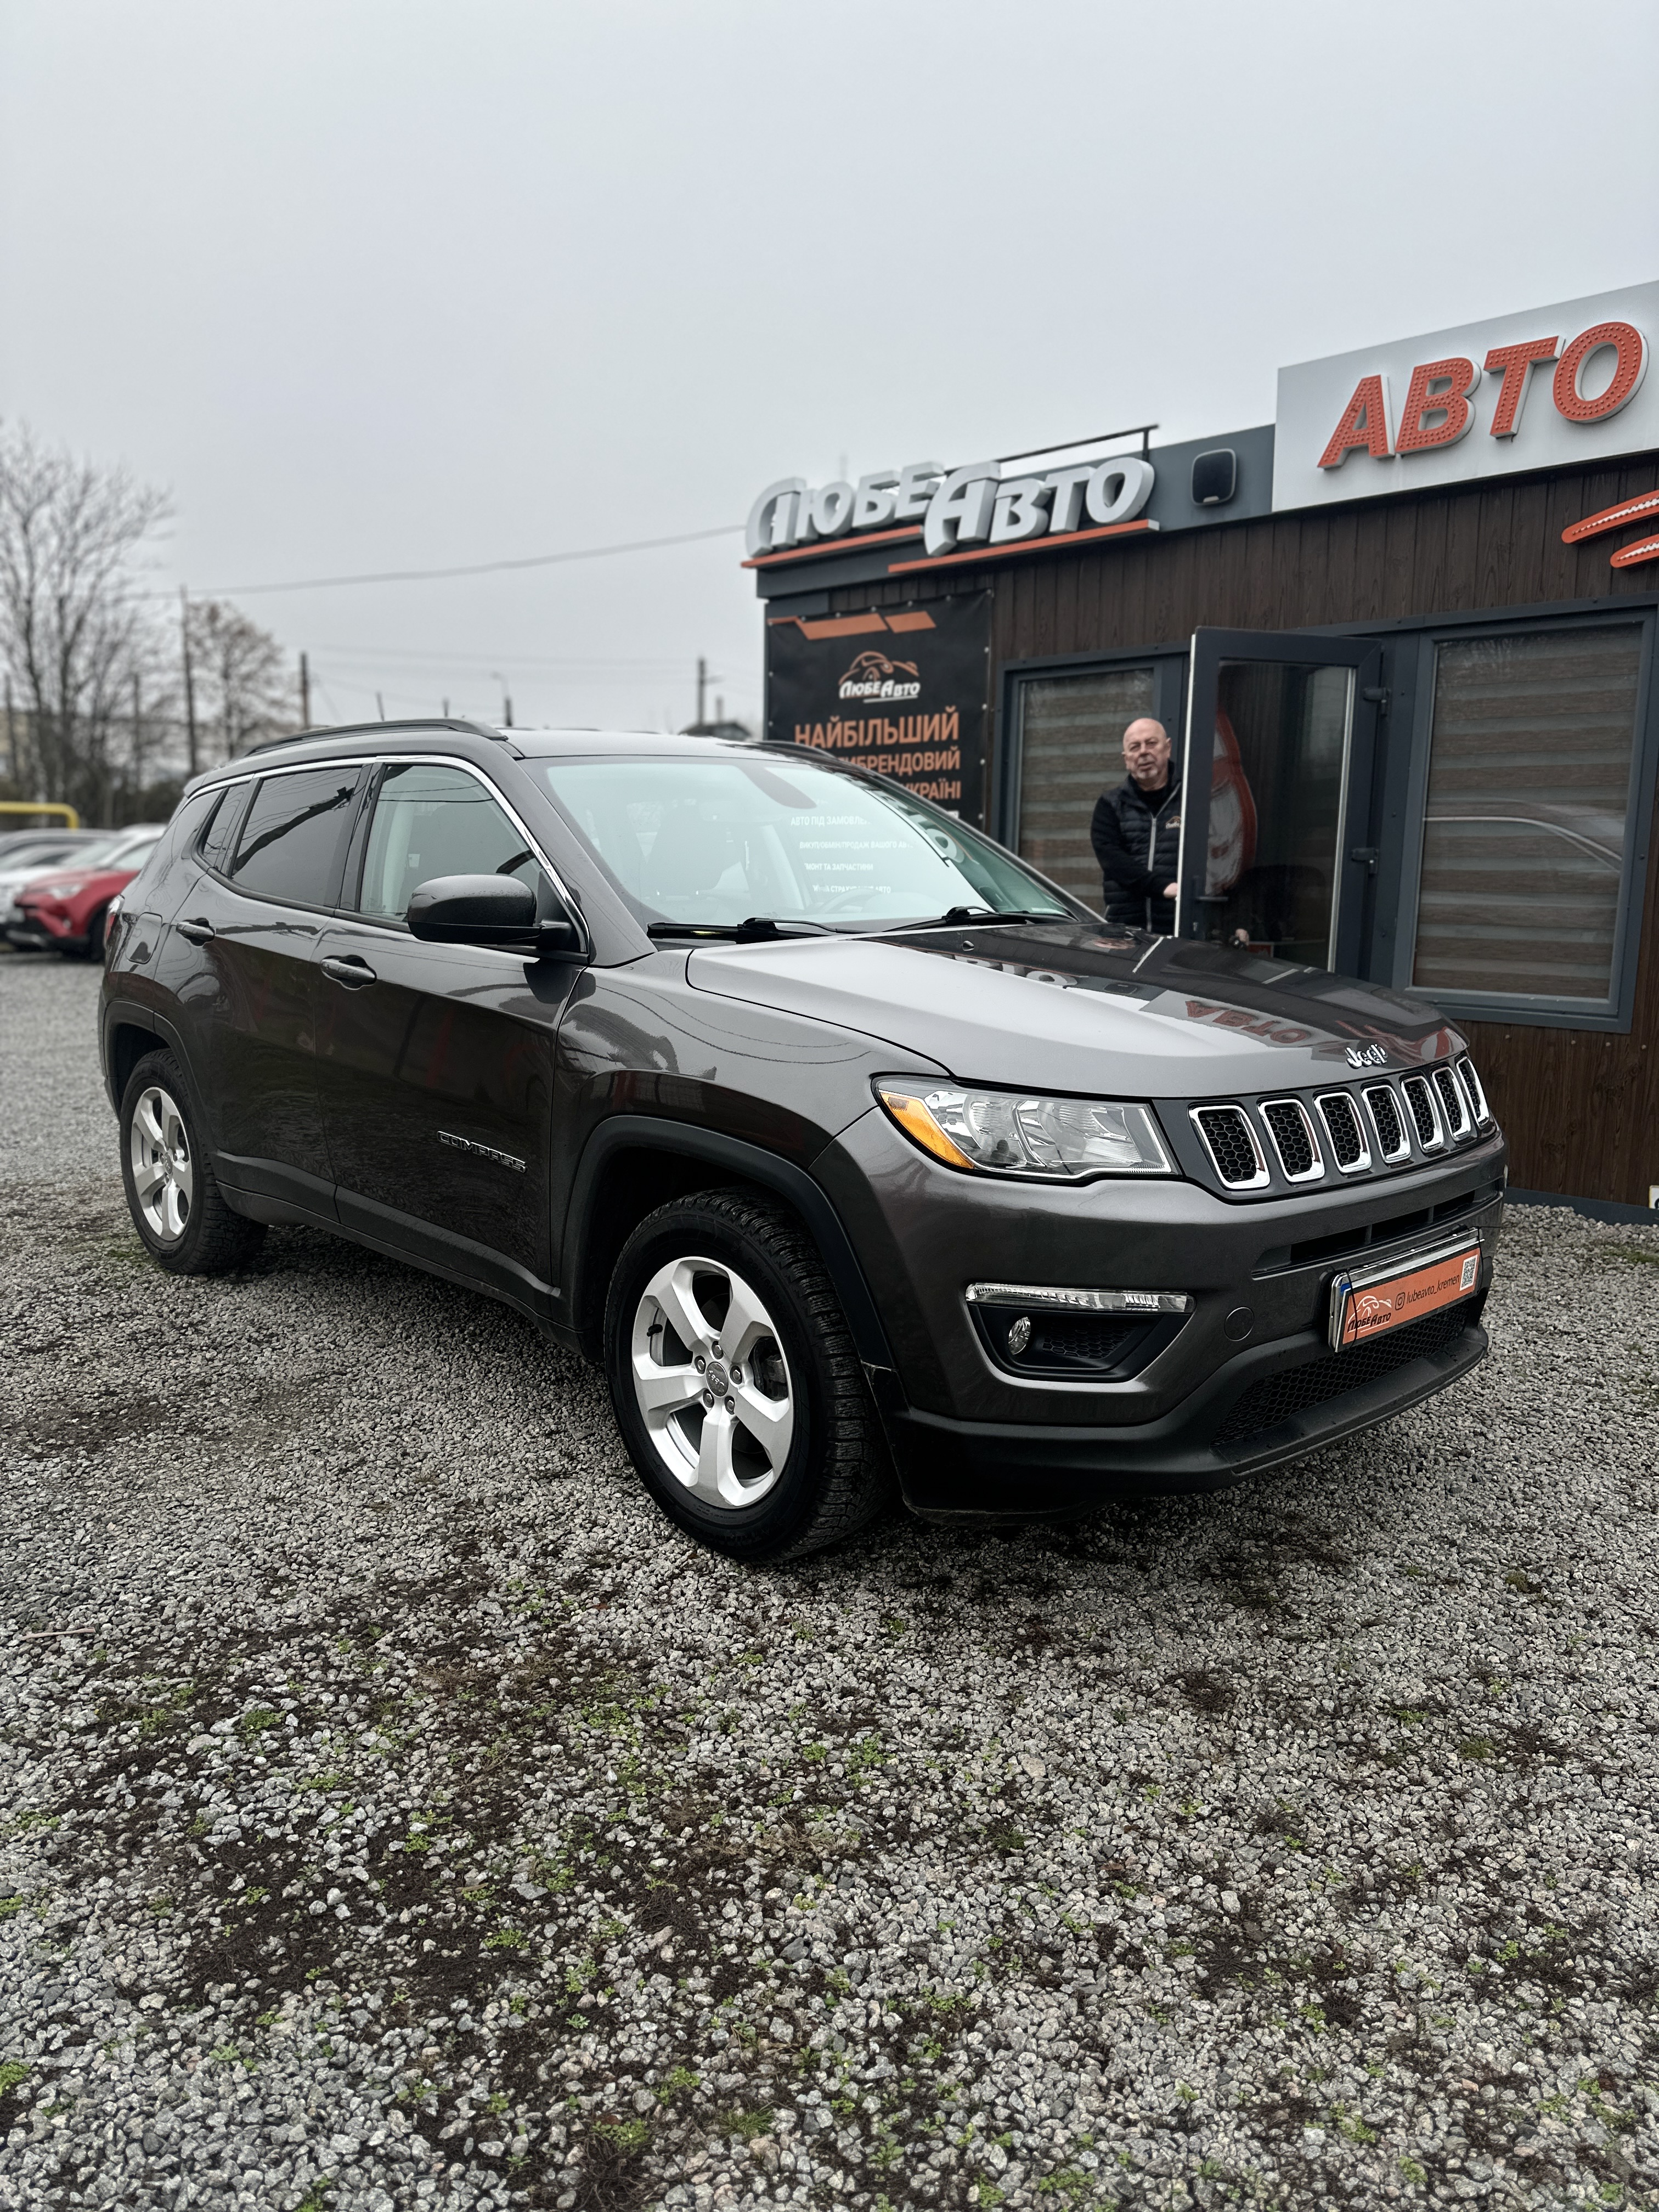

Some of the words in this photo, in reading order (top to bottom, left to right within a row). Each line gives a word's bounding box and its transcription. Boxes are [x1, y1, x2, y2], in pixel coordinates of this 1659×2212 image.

[1317, 321, 1648, 470] АВТО
[794, 706, 960, 748] НАЙБІЛЬШИЙ
[791, 816, 810, 826] АВТО
[811, 816, 825, 827] ПІД
[1345, 1043, 1388, 1069] Jeep
[436, 1131, 528, 1173] COMPASS
[1407, 1274, 1460, 1305] lubeavto_kremen
